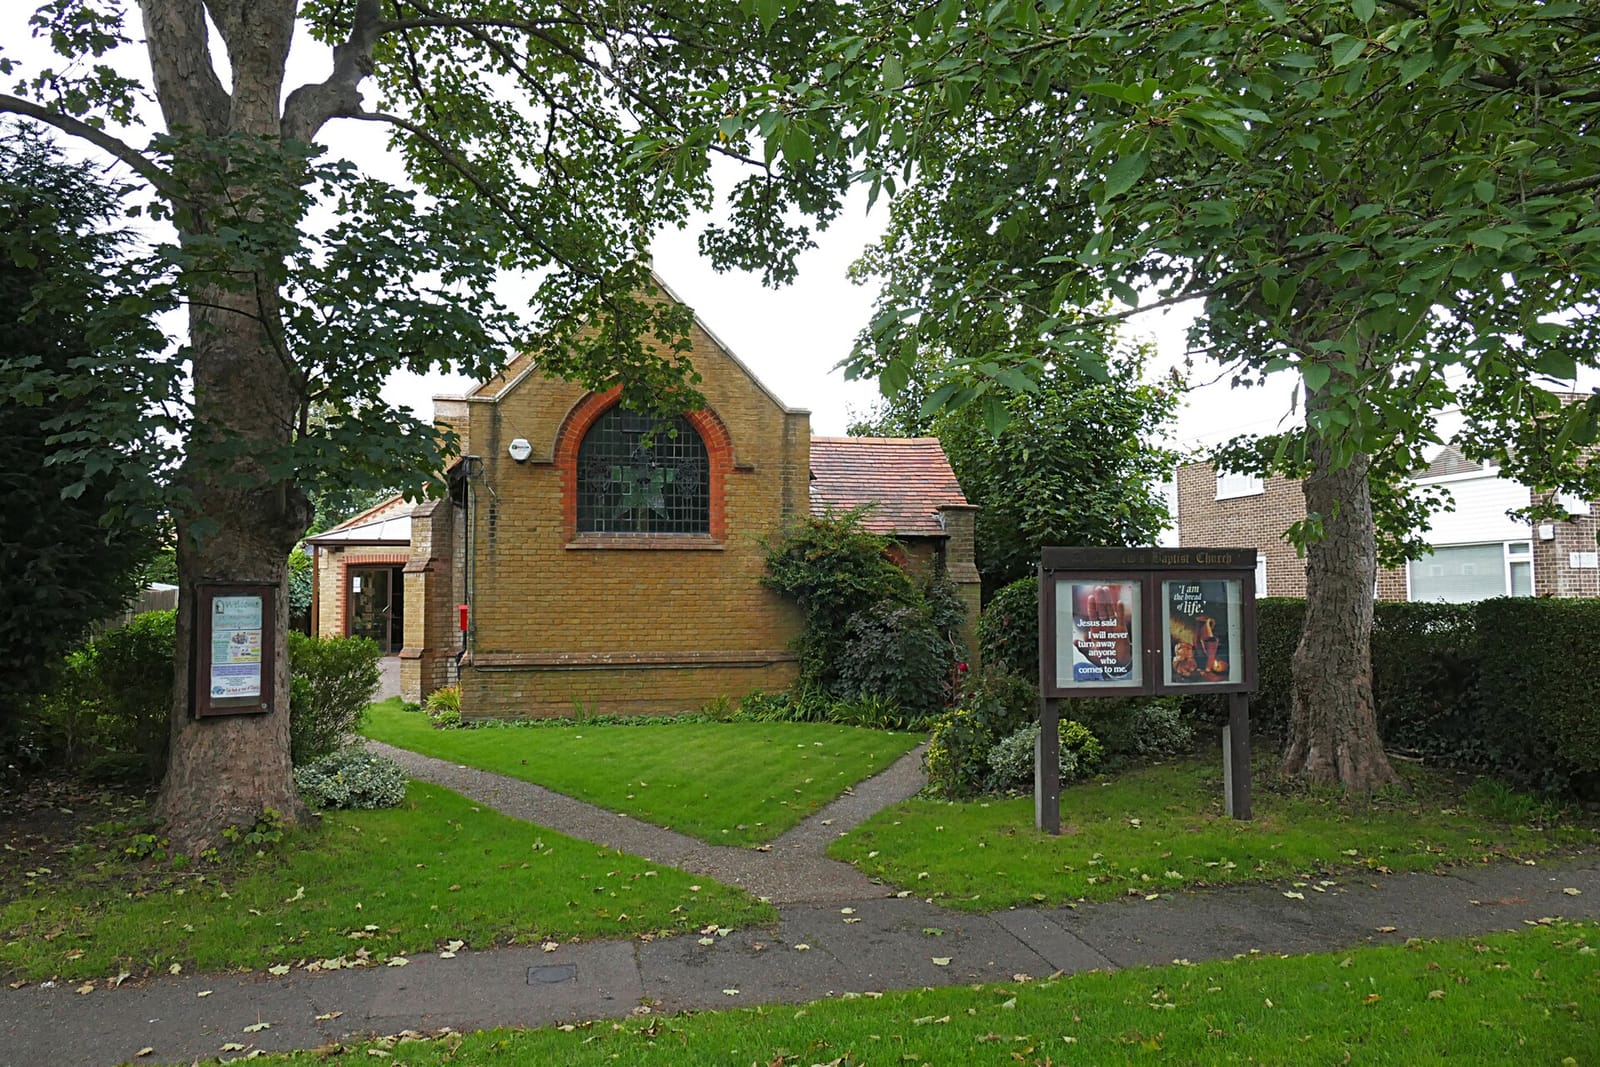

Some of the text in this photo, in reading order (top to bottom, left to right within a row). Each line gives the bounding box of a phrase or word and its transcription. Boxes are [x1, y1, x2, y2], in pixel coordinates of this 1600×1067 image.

[1152, 551, 1189, 565] Baptist
[1196, 551, 1232, 565] Church
[1186, 585, 1200, 593] am
[1173, 593, 1202, 601] the bread
[1176, 603, 1183, 611] of
[1077, 618, 1117, 628] Jesus said
[1088, 631, 1129, 639] I will never
[1078, 640, 1116, 649] turn away
[1088, 650, 1117, 658] anyone
[1100, 657, 1117, 665] who
[1078, 665, 1128, 674] comes to me.
